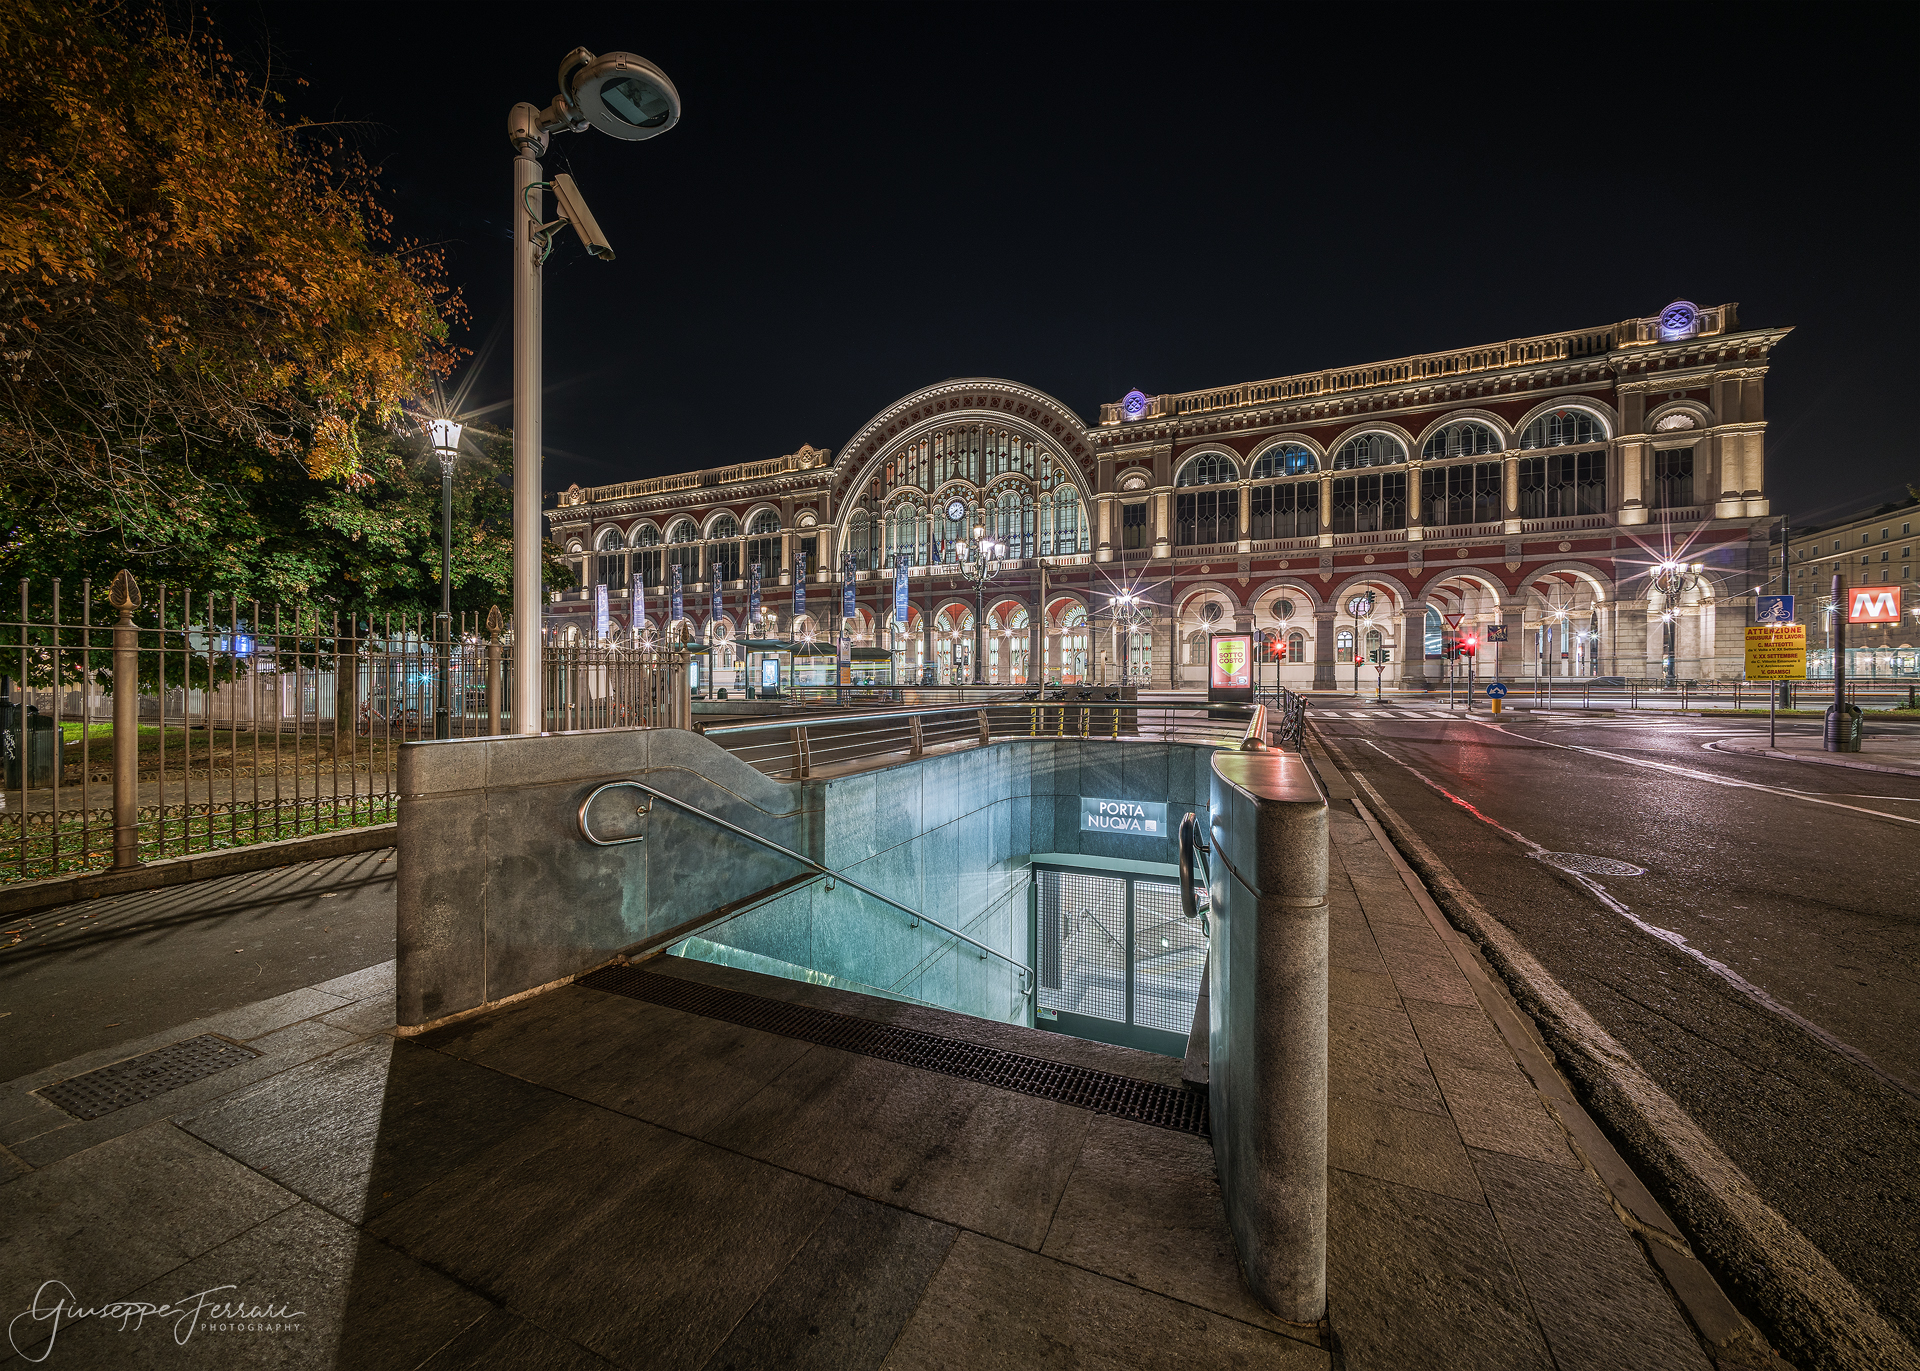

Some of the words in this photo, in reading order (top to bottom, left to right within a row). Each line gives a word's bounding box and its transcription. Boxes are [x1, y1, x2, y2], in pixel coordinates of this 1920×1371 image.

[1851, 592, 1898, 617] M
[1100, 802, 1144, 817] PORTA
[1088, 814, 1142, 830] NUOVA
